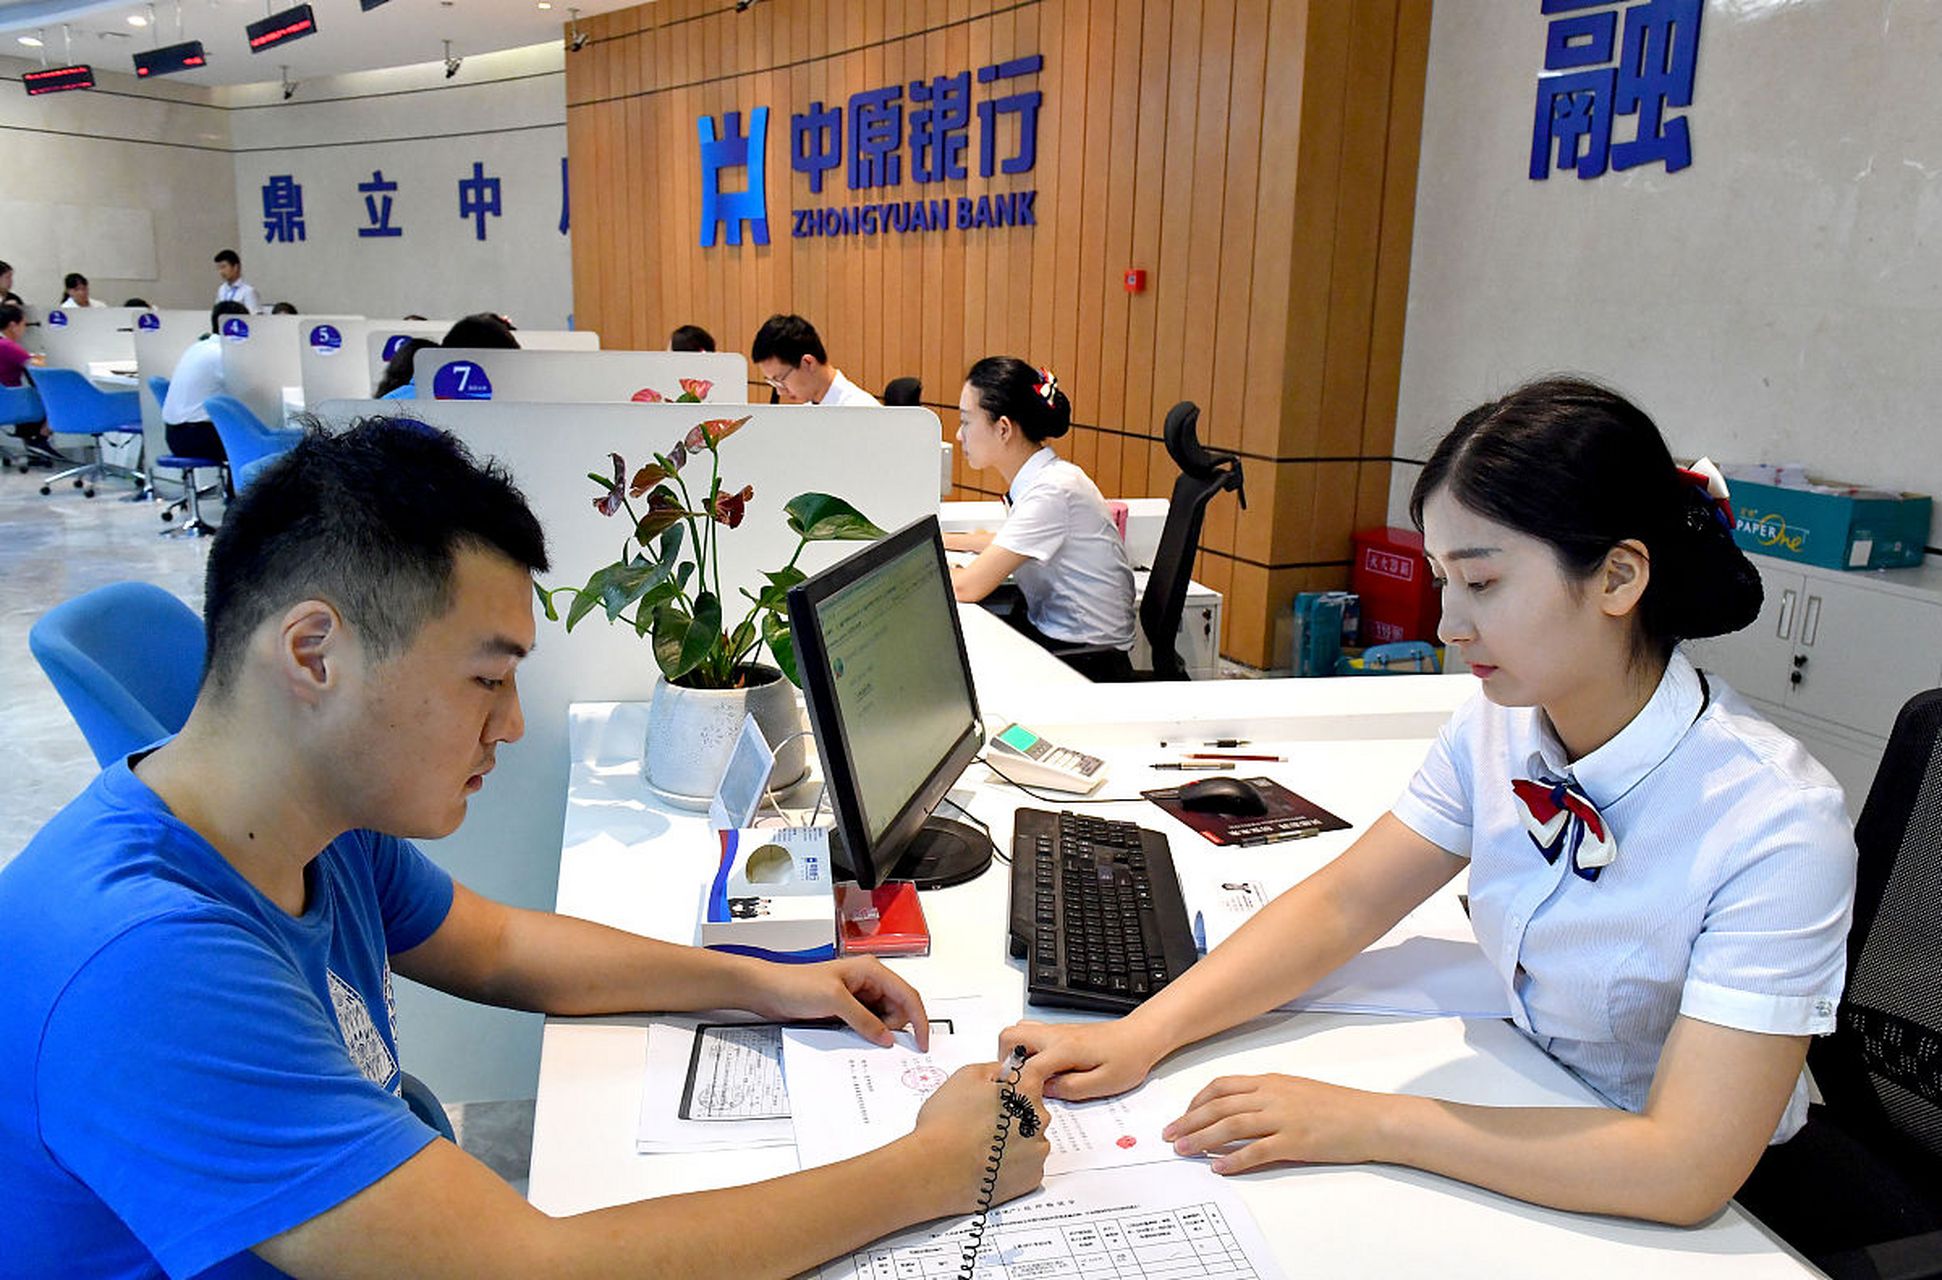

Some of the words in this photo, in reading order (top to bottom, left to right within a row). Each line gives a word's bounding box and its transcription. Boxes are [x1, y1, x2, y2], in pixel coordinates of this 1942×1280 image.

[1529, 0, 1705, 181] 融
[790, 54, 1044, 194] 中原银行
[792, 199, 950, 238] ZHONGYUAN
[956, 190, 1038, 231] BANK
[230, 320, 240, 333] 4
[319, 327, 330, 343] 5
[453, 366, 471, 392] 7
[1735, 519, 1777, 539] PAPER
